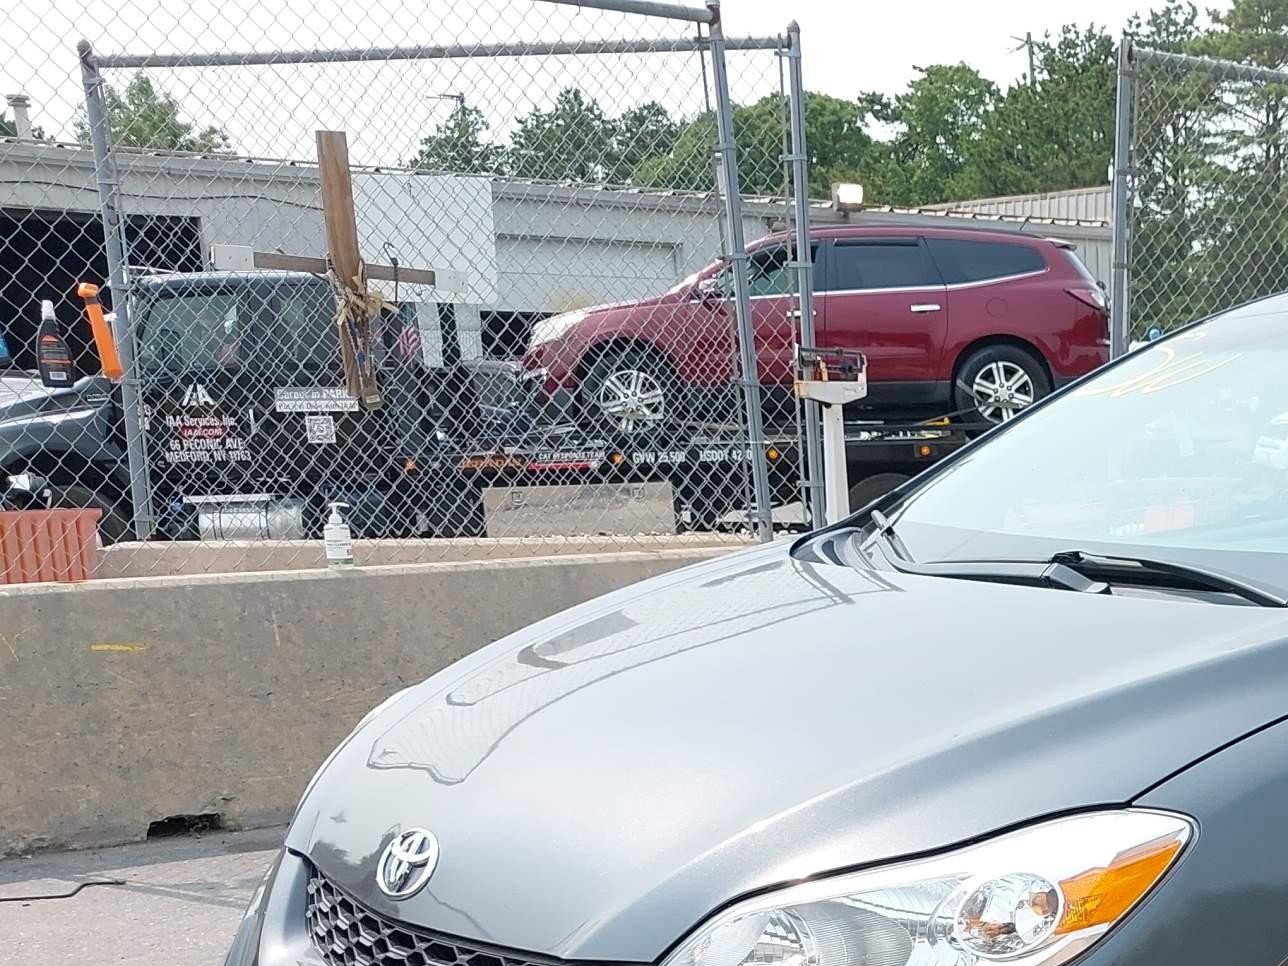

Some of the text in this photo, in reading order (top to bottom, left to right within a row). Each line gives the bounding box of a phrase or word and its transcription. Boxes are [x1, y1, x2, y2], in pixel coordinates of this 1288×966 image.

[170, 440, 180, 450] 66
[226, 438, 244, 449] AVE
[214, 450, 226, 461] NY
